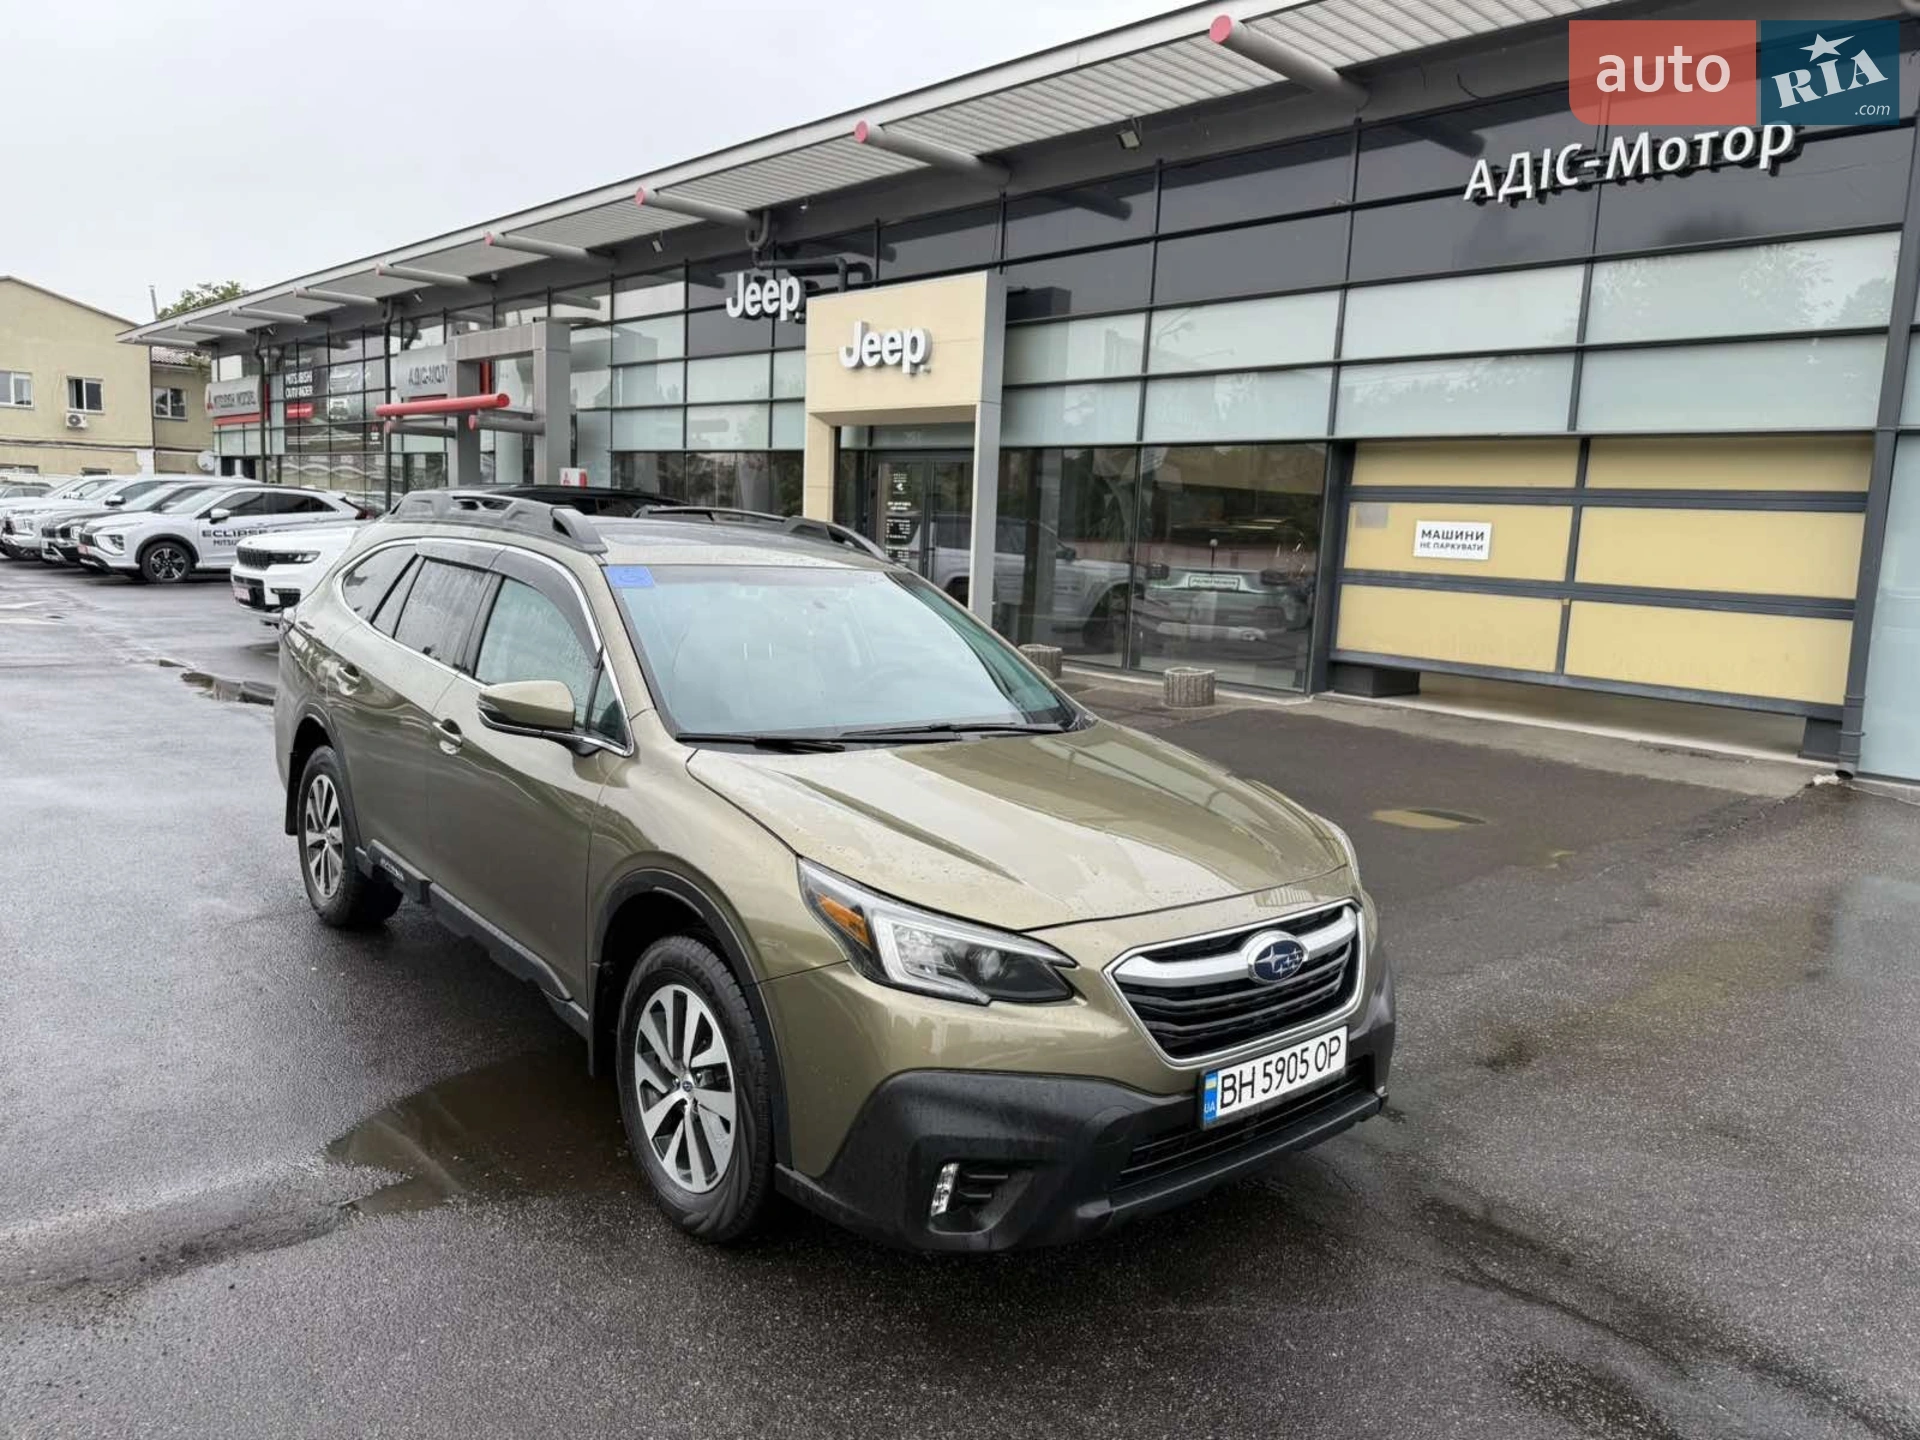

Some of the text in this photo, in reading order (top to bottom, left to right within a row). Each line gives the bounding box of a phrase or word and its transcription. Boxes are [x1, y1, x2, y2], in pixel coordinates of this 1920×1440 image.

[1463, 123, 1795, 203] АДІС-Мотор
[725, 271, 801, 321] Jeep
[838, 319, 927, 374] Jeep
[1421, 529, 1484, 541] МАШИНИ
[1433, 542, 1484, 551] ПАРКУВАТИ
[1220, 1036, 1341, 1109] BH 5905 OP
